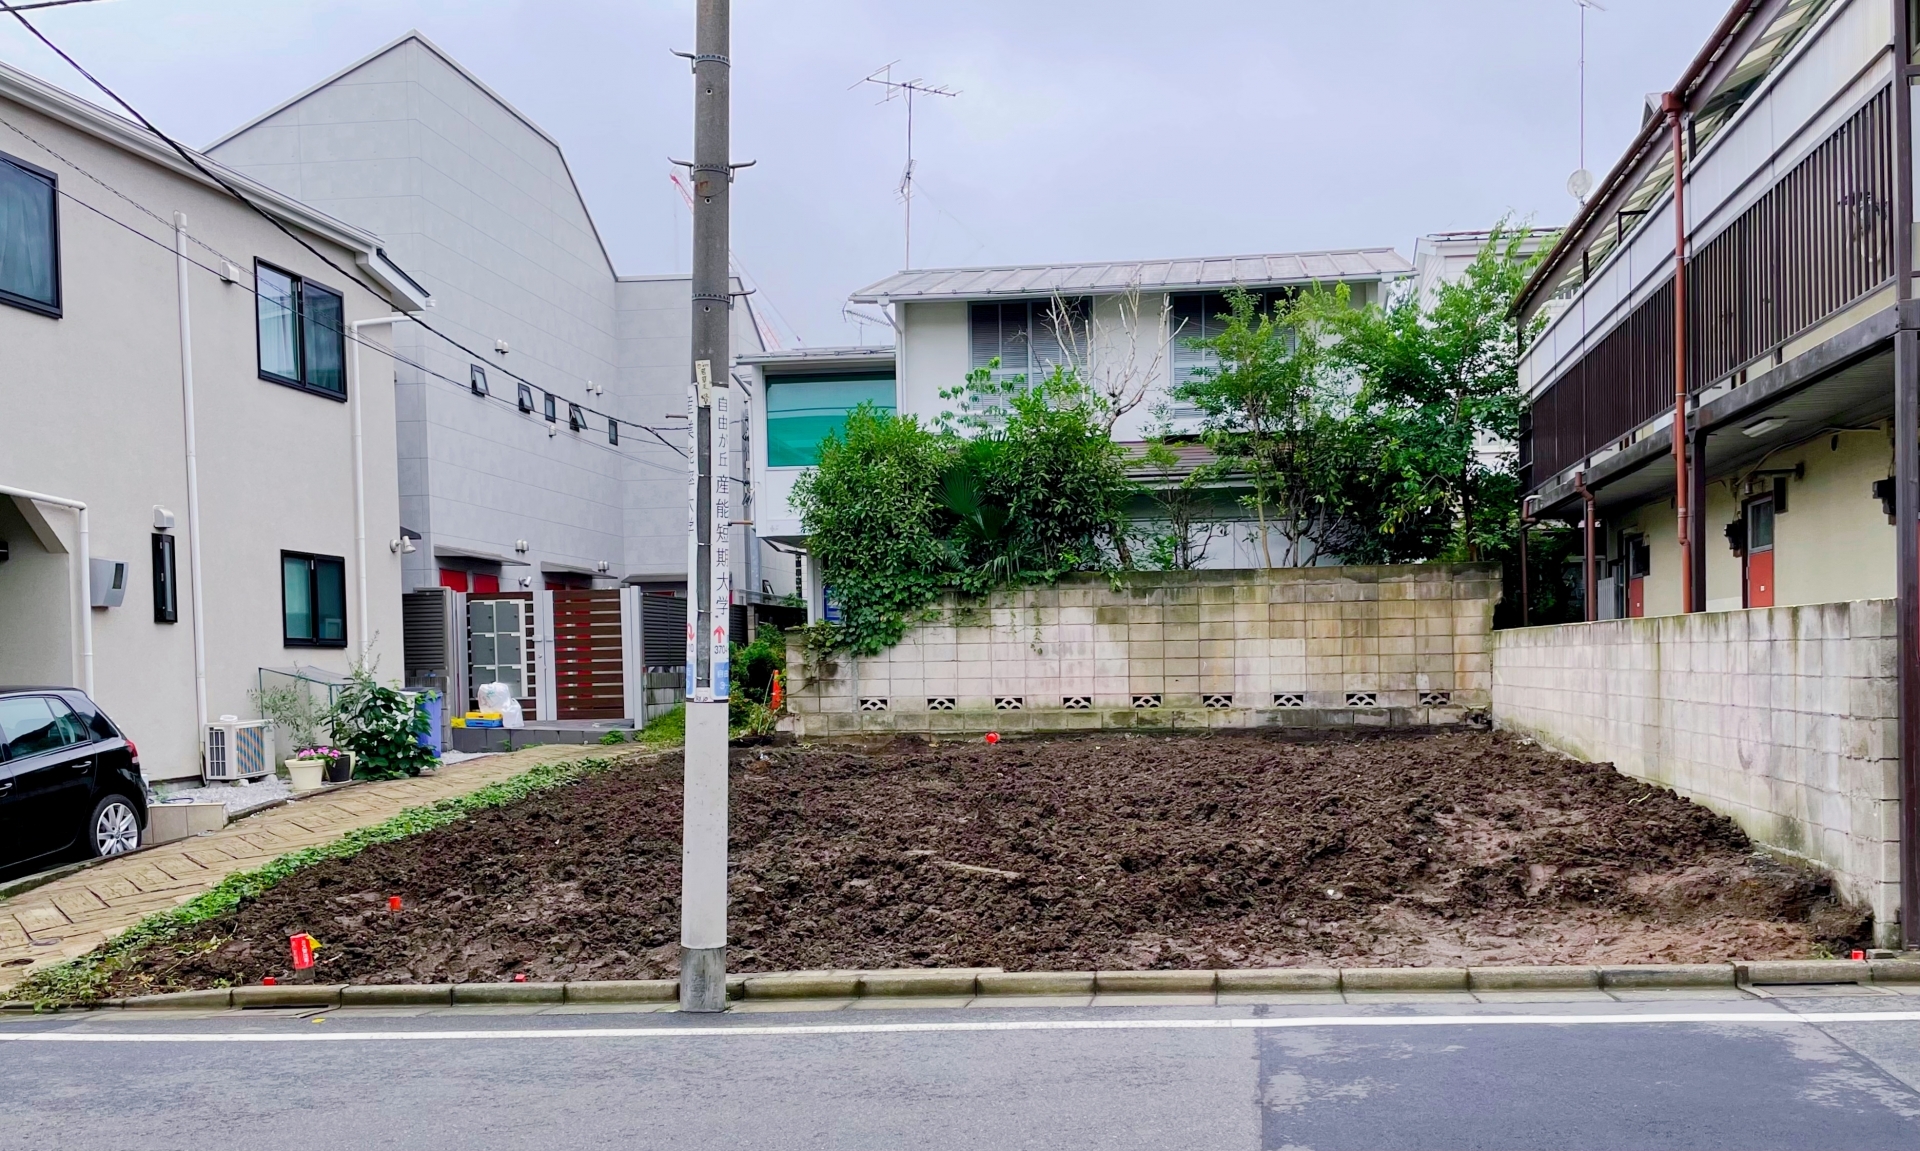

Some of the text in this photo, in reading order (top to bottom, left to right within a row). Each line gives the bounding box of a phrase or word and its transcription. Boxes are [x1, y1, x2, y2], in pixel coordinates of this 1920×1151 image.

[715, 397, 729, 615] 自由が丘産能短期大学
